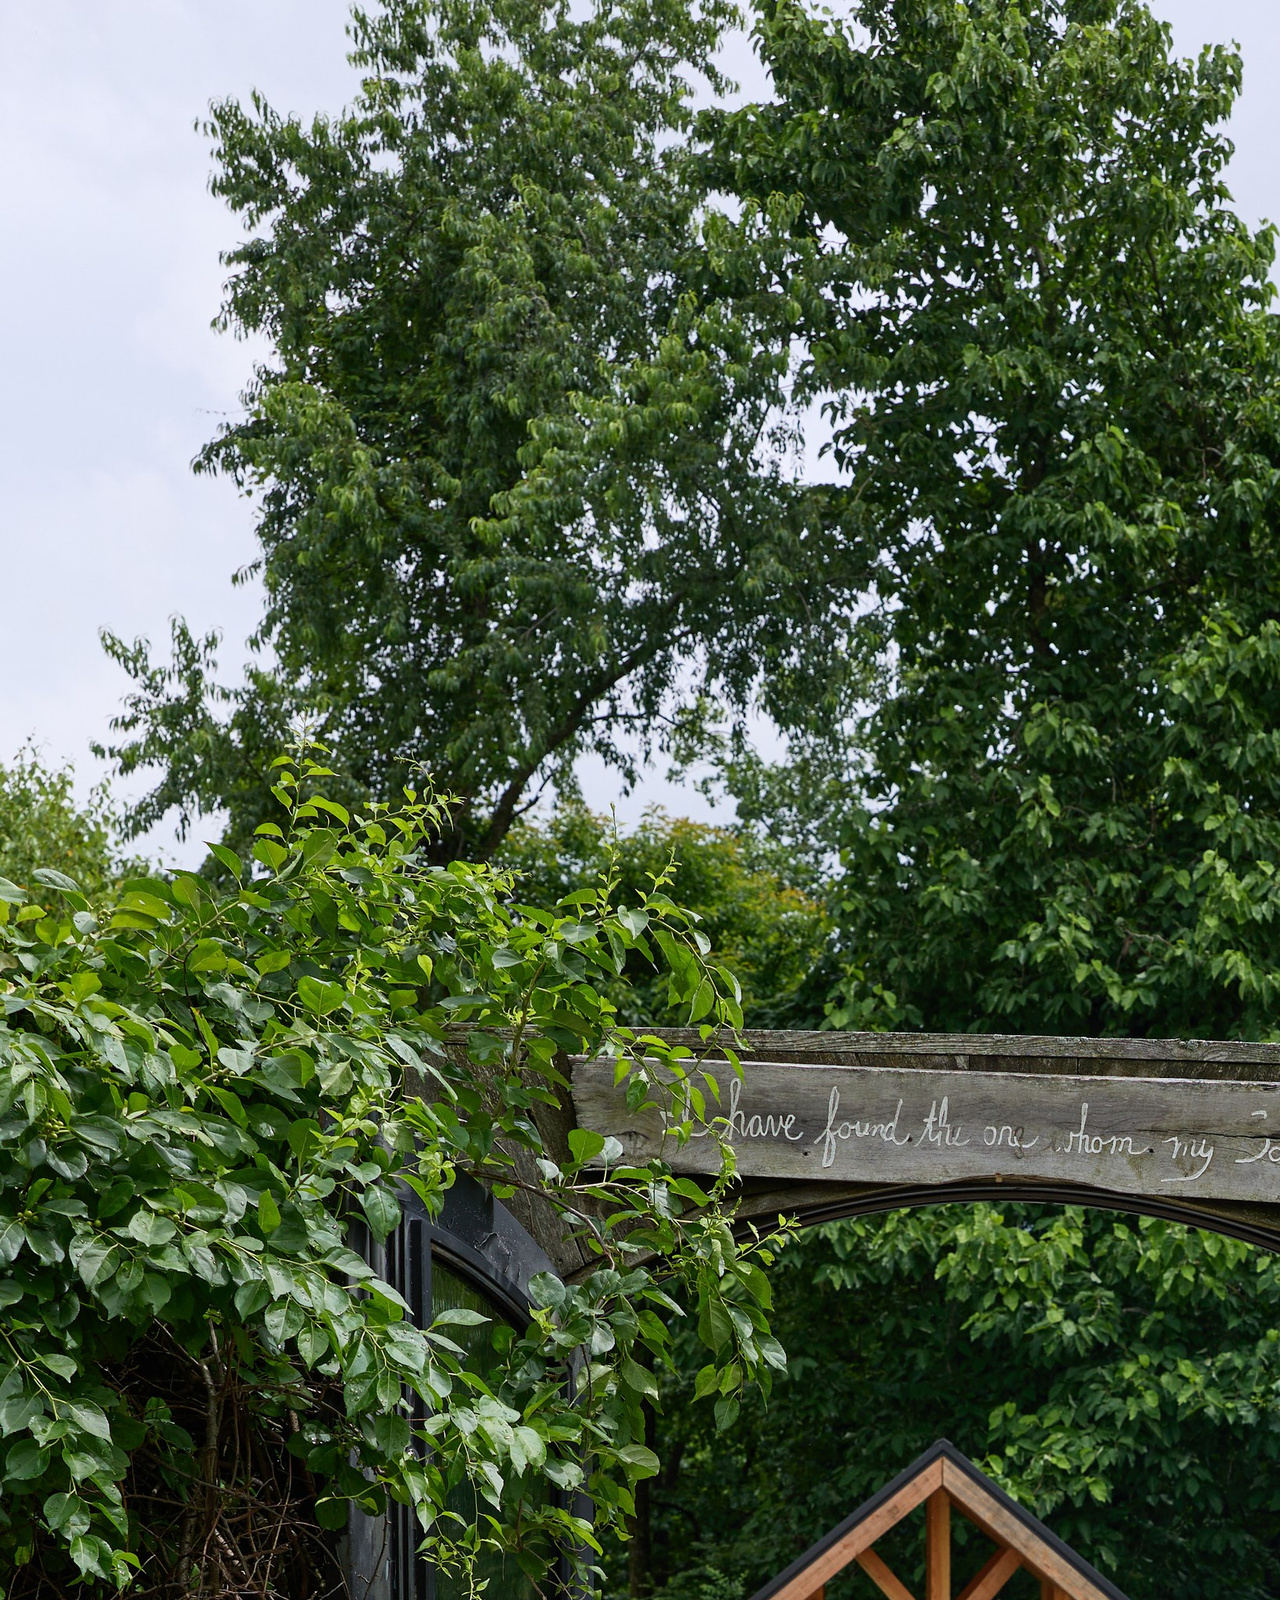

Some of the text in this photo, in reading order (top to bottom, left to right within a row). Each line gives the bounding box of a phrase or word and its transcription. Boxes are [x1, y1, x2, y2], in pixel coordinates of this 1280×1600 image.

[719, 1078, 804, 1140] have
[814, 1086, 911, 1168] found
[915, 1096, 971, 1147] the
[1161, 1136, 1214, 1182] my
